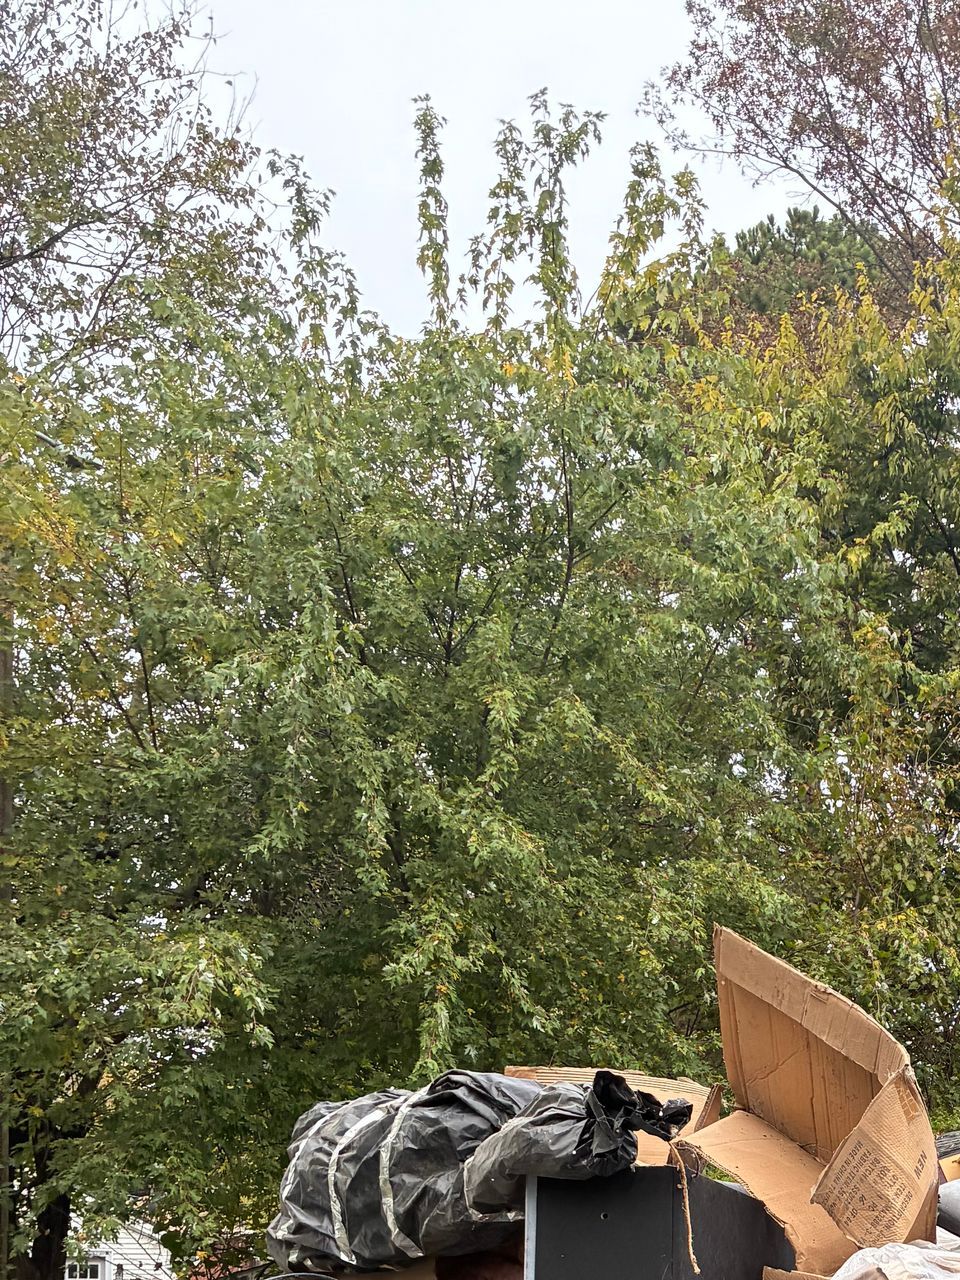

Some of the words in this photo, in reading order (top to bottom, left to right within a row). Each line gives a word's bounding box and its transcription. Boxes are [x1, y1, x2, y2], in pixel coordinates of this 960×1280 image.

[848, 1139, 863, 1160] MADE
[852, 1148, 871, 1172] FABRIC
[844, 1156, 851, 1166] IN
[861, 1156, 880, 1180] BATCH
[912, 1150, 927, 1180] NEW
[832, 1164, 847, 1185] CHINA
